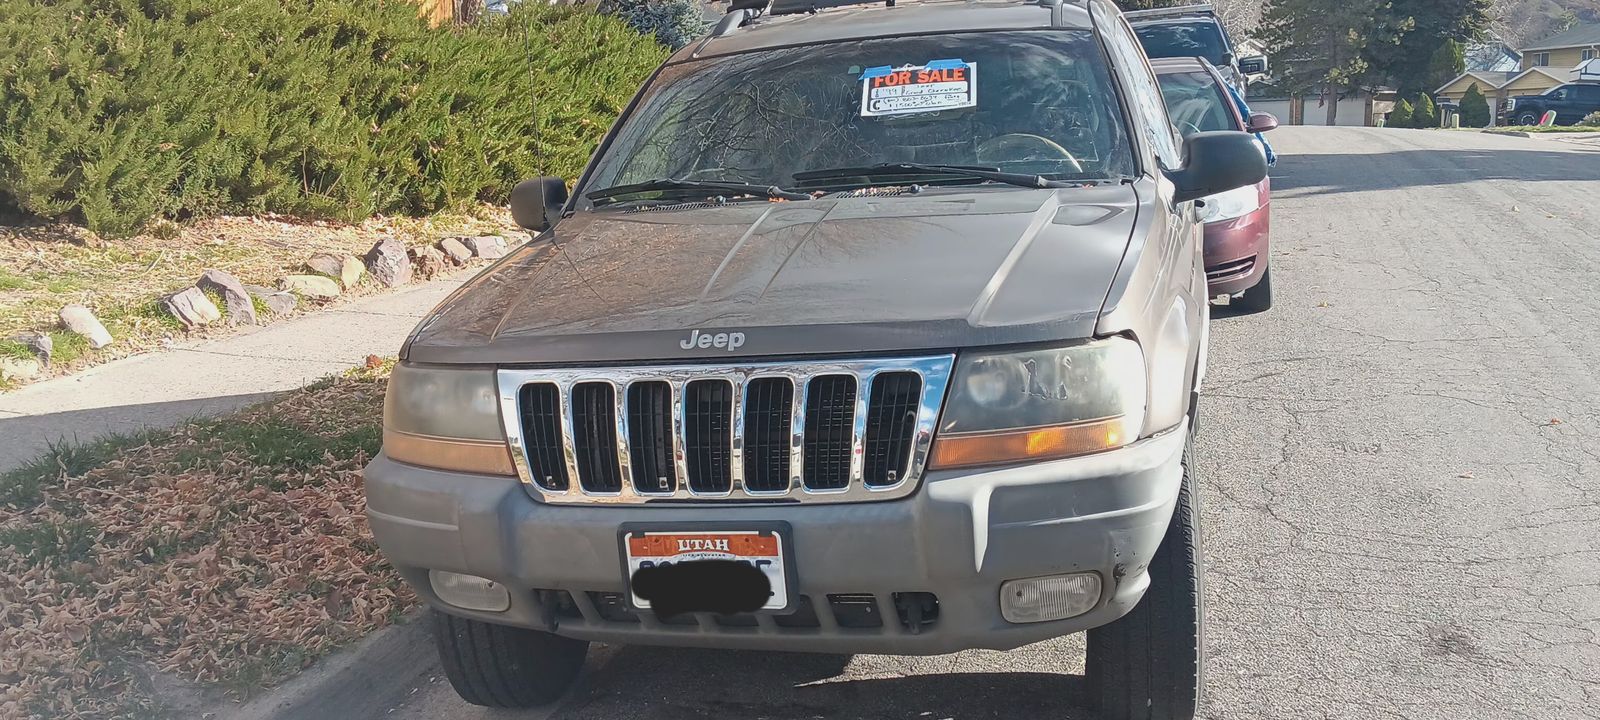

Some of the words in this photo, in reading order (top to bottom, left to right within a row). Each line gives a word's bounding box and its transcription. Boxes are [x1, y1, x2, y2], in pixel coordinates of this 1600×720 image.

[874, 71, 912, 87] FOR
[917, 68, 965, 83] SALE
[680, 329, 746, 351] Jeep
[677, 539, 730, 551] UTAH
